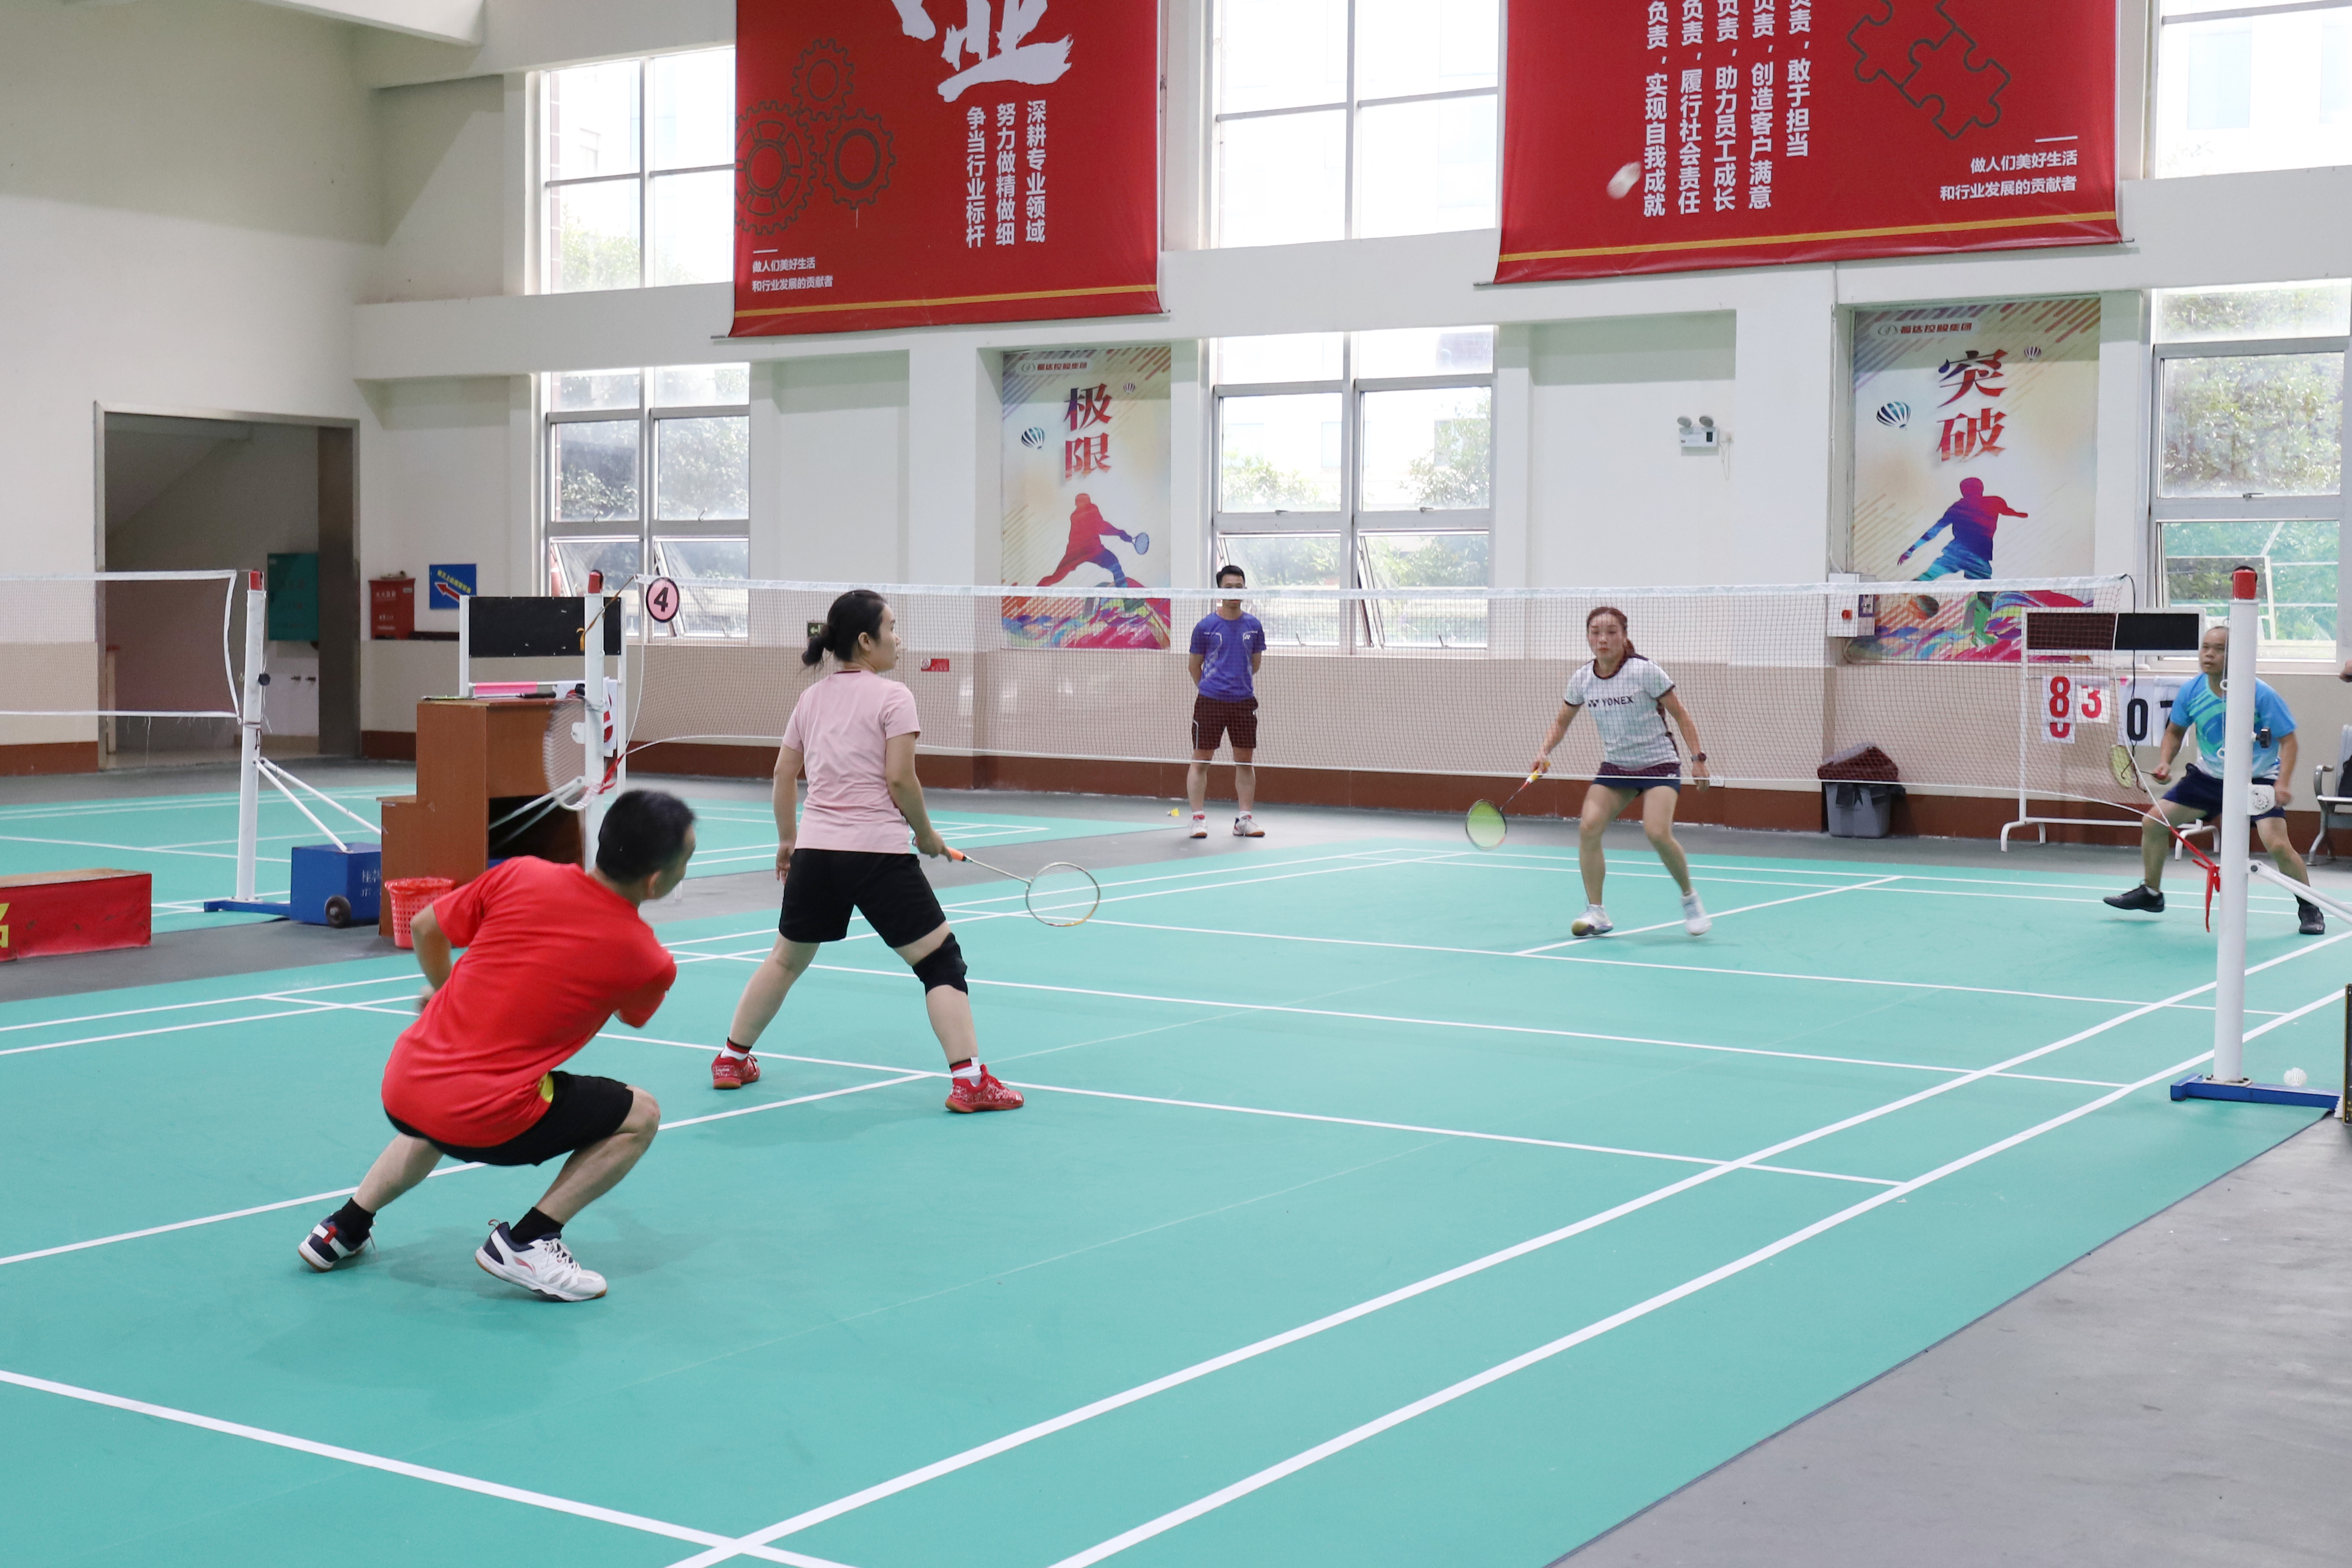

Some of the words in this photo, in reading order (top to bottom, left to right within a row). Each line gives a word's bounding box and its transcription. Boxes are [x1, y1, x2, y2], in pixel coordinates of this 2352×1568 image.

[1786, 0, 1812, 157] 责，敢于担当
[966, 106, 987, 249] 争当行业标杆
[995, 103, 1016, 246] 努力做精做细
[1025, 100, 1047, 243] 深耕专业领域
[1940, 175, 2078, 201] 和行业发展的贡献者
[1970, 149, 2078, 174] 做人们美好生活
[752, 257, 816, 273] 做人们美好生活
[752, 275, 833, 293] 和行业发展的贡献者
[1063, 383, 1113, 481] 极限
[1936, 349, 2008, 463] 突破
[654, 587, 669, 612] 4
[1602, 695, 1634, 706] YONEX
